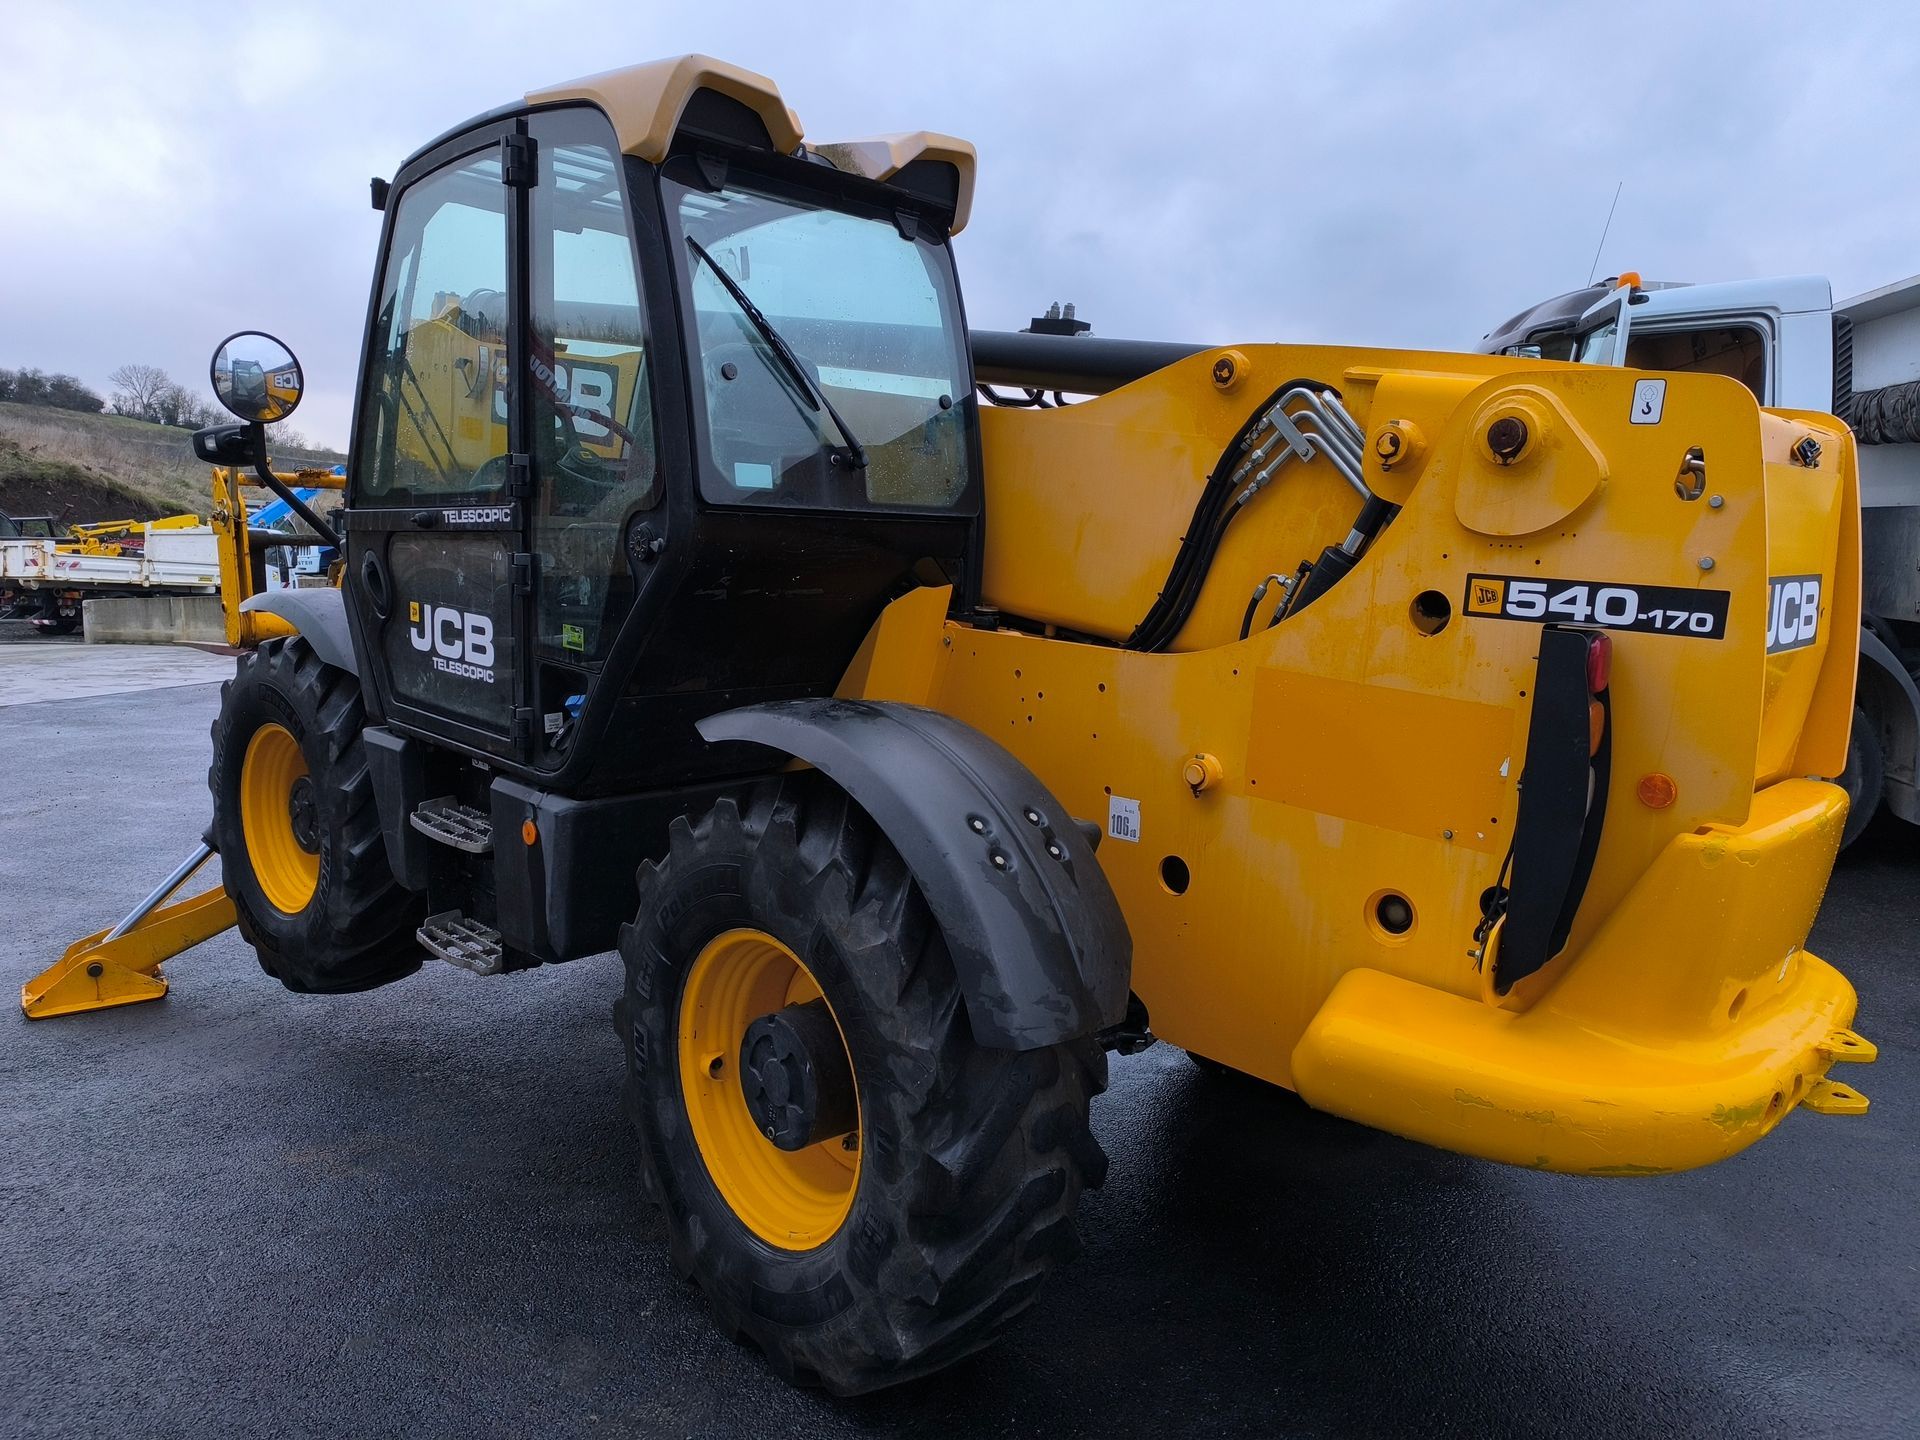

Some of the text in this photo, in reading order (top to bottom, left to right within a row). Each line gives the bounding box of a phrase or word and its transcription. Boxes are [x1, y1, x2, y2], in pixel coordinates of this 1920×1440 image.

[442, 508, 512, 524] TELESCOPIC
[1478, 587, 1497, 603] JCB
[1505, 580, 1715, 633] 540-170
[410, 603, 495, 667] JCB
[432, 656, 495, 685] TELESCOPIC
[1111, 813, 1130, 836] 106
